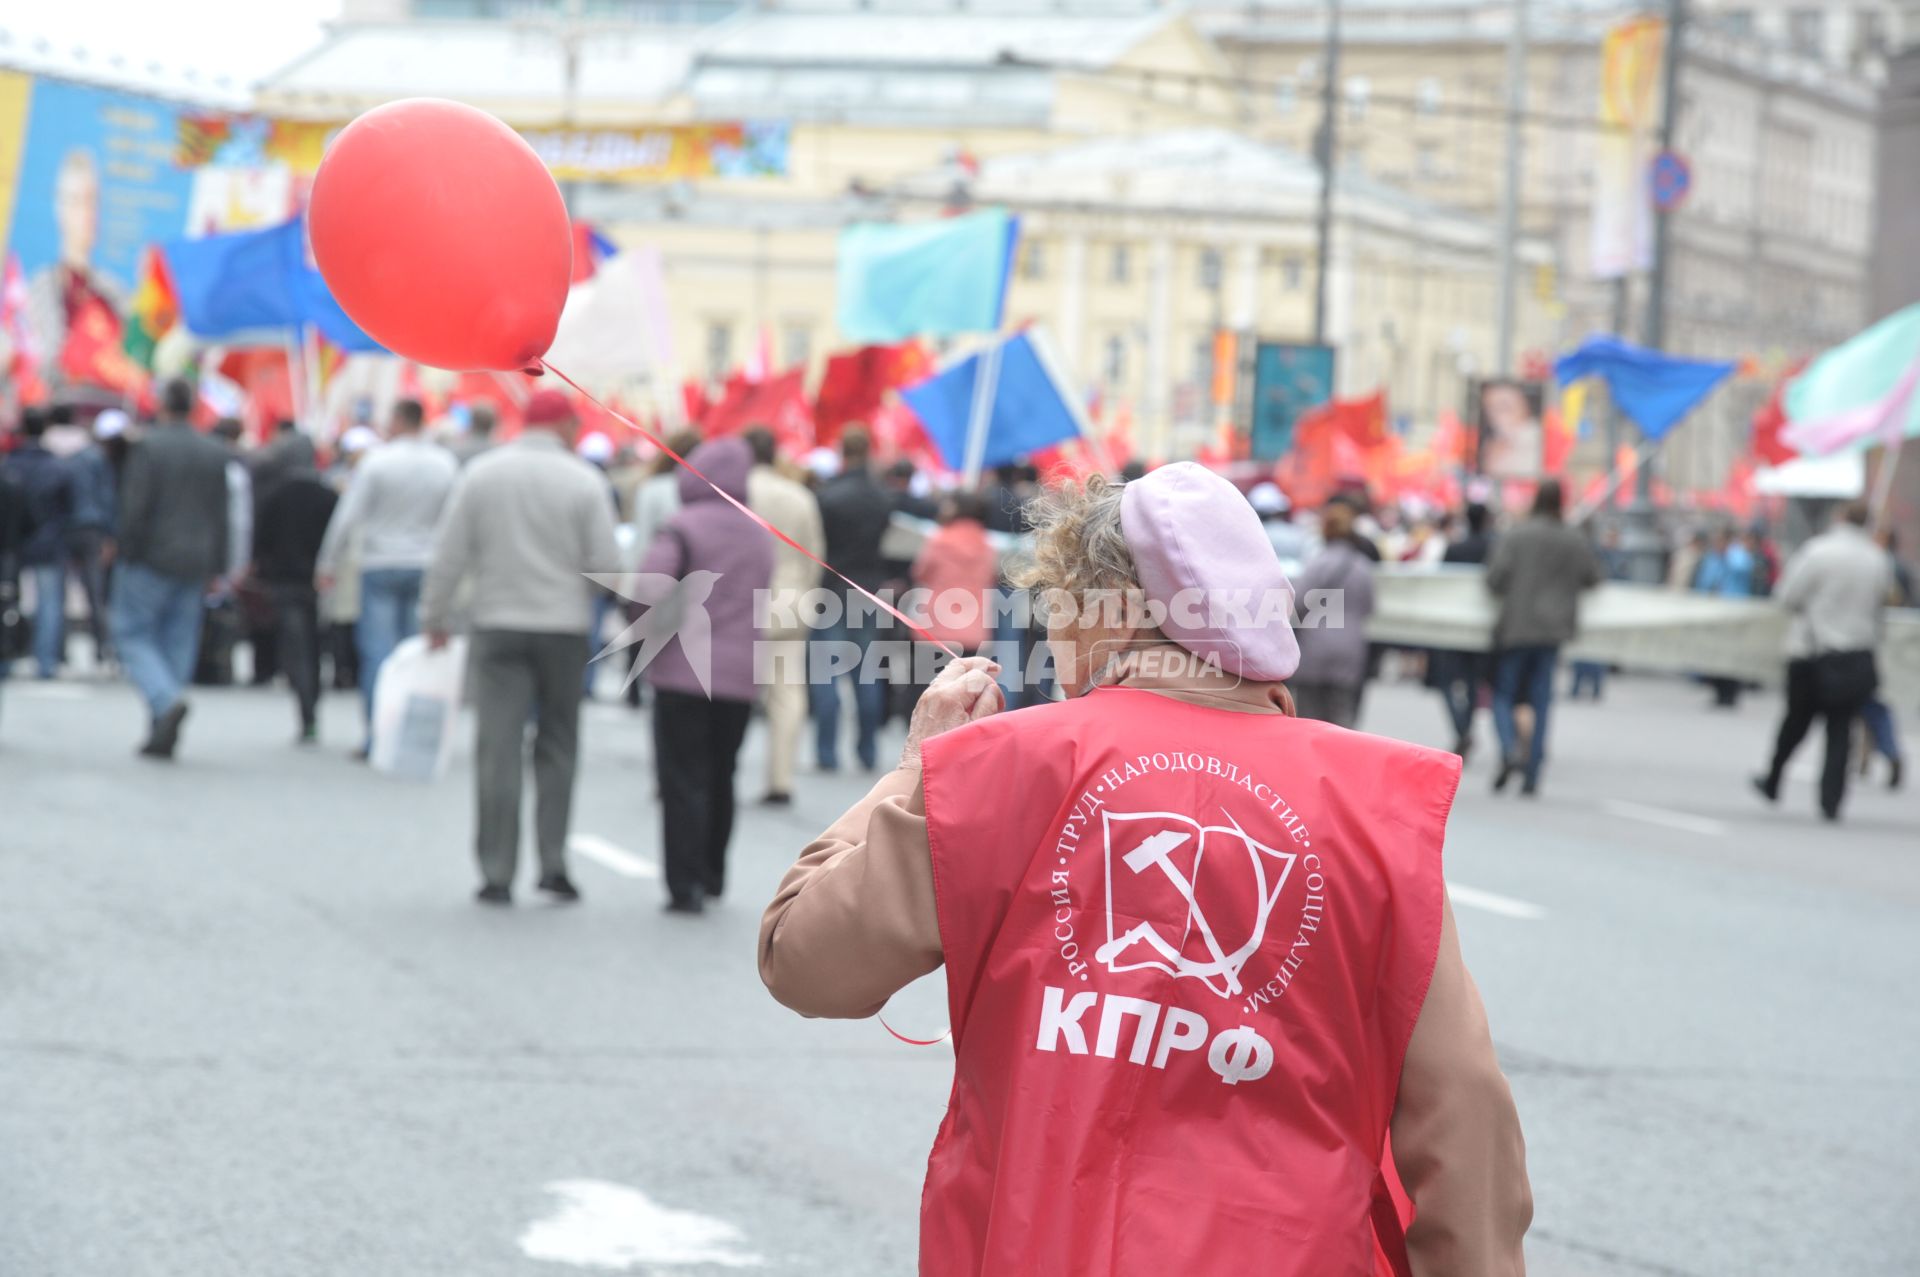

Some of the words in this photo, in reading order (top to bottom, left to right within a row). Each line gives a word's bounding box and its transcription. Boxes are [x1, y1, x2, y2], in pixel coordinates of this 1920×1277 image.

[1056, 790, 1105, 855] ТРУД
[1102, 752, 1309, 843] НАРОДОВЛАСТИЕ
[1050, 869, 1089, 977] РОССИЯ
[1248, 853, 1324, 1014] СОЦИАЛИЗМ
[1036, 985, 1274, 1086] КПРФ
